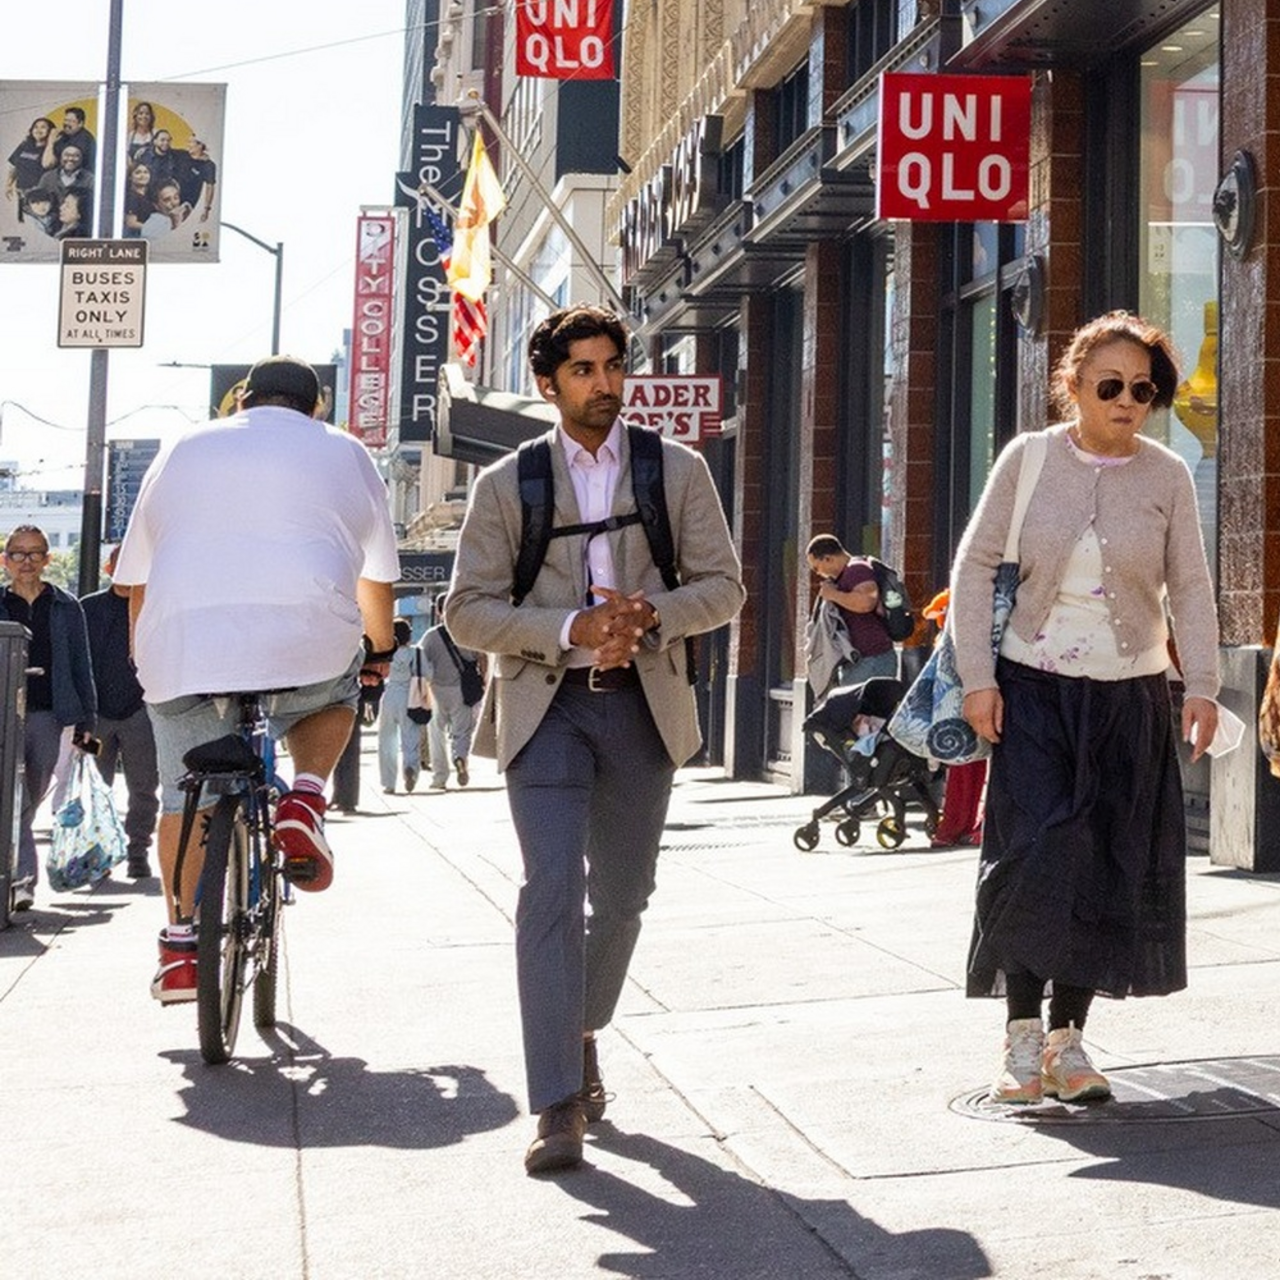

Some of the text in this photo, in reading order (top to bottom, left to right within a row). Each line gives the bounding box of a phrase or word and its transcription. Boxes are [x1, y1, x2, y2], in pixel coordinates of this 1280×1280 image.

[525, 32, 604, 73] QLO
[898, 91, 1003, 142] UNI
[419, 120, 451, 184] The
[897, 151, 1012, 209] QLO
[68, 247, 141, 259] RIGHT LANE
[72, 272, 135, 285] BUSES
[74, 291, 131, 304] TAXIS
[75, 310, 128, 324] ONLY
[66, 328, 136, 339] AT ALL TIMES
[358, 301, 385, 429] COLLEGE
[627, 384, 712, 408] ADER
[401, 566, 445, 580] SSER
